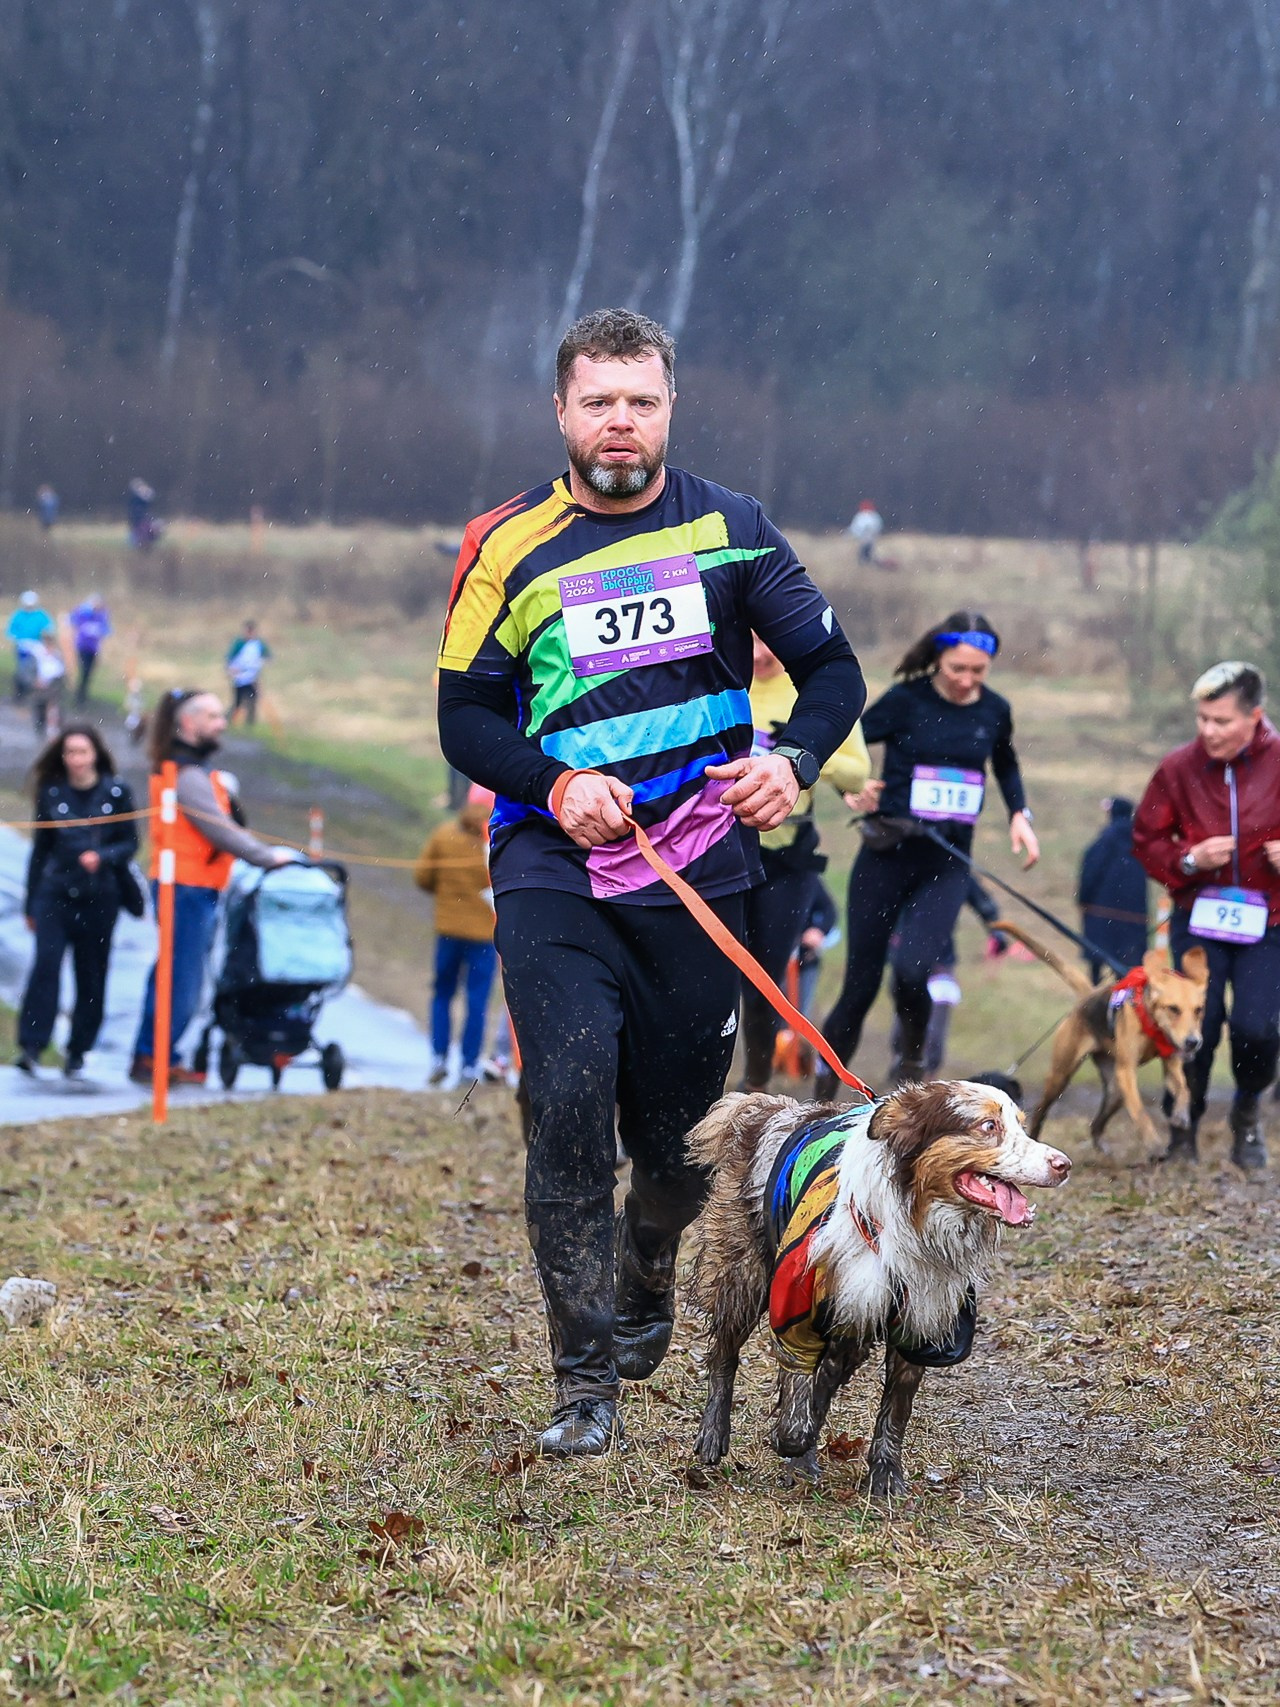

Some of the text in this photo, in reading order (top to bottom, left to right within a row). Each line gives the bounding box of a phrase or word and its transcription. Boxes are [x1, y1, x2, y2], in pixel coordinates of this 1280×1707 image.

[601, 565, 652, 581] КРОСС
[662, 570, 671, 579] 2
[565, 577, 594, 590] 11/04
[566, 585, 596, 598] 2026
[594, 597, 675, 645] 373
[1216, 905, 1242, 926] 95
